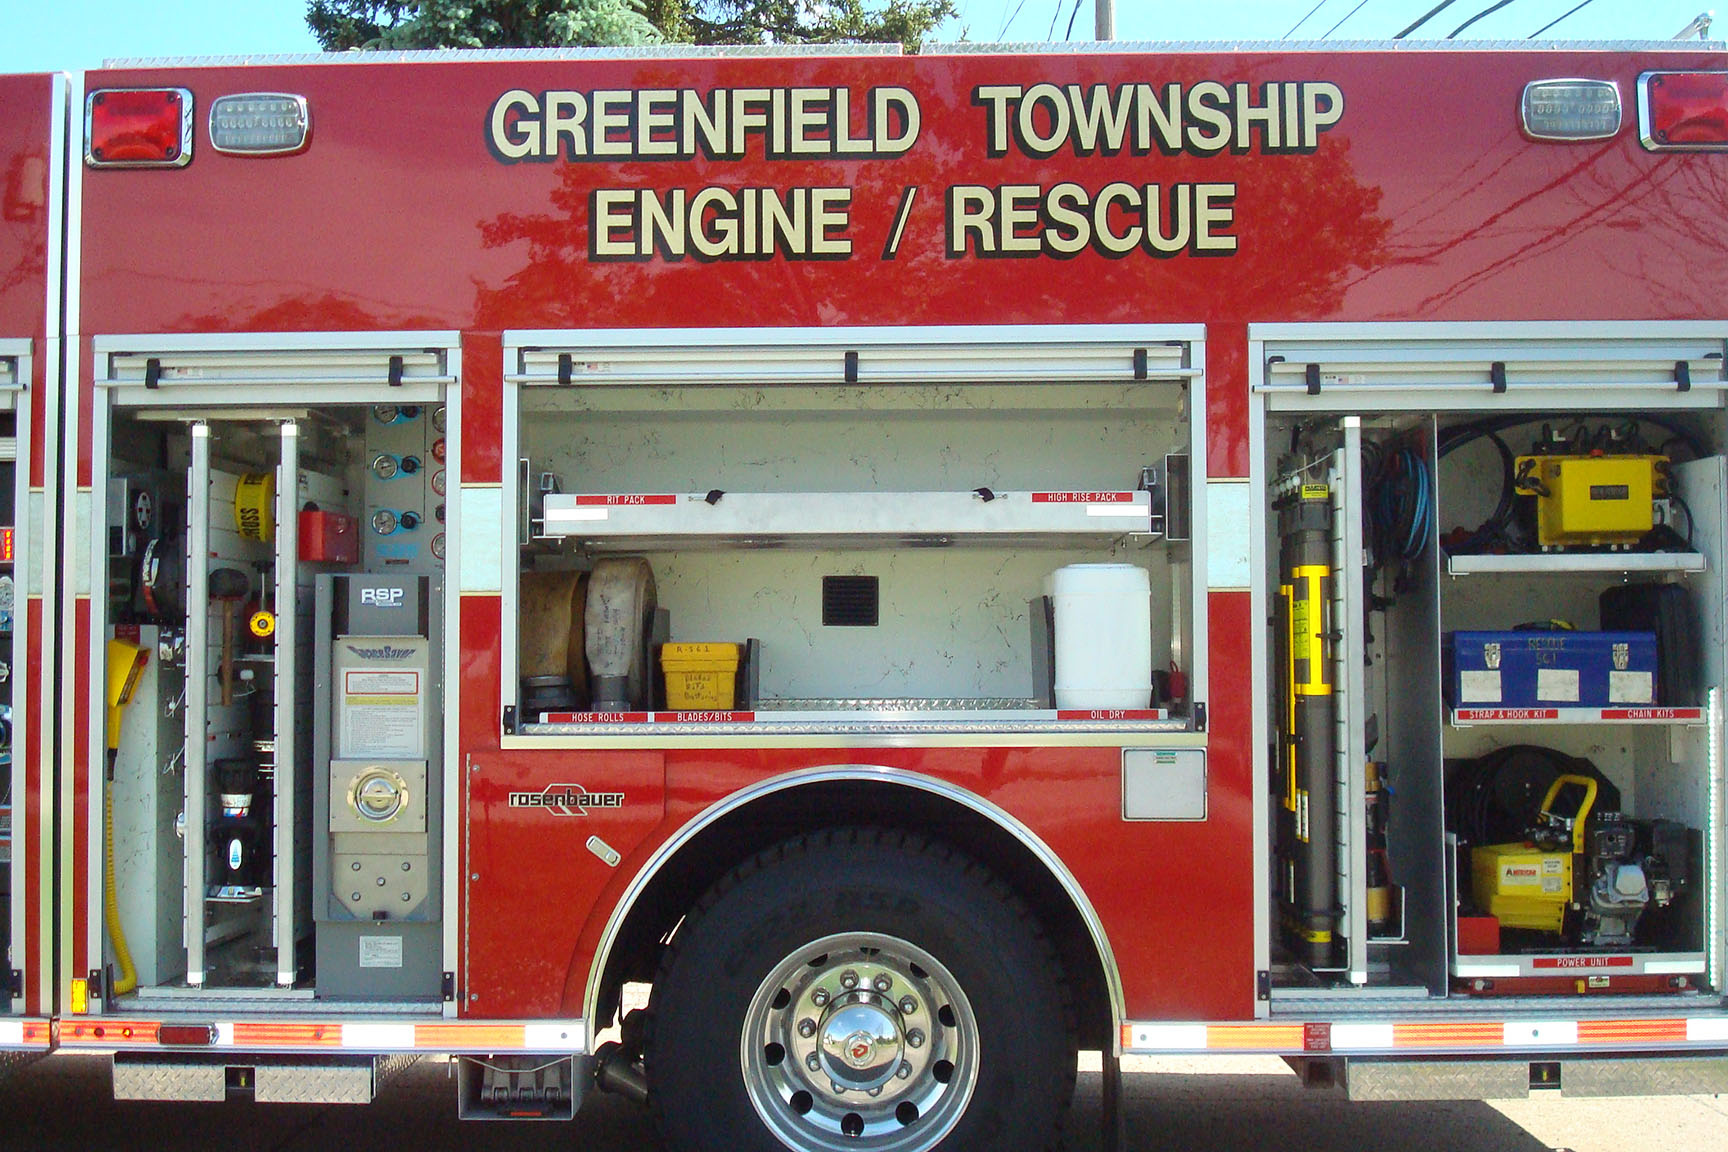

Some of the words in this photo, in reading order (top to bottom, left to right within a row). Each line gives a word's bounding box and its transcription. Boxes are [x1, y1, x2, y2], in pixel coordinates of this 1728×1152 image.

[487, 87, 921, 161] GREENFIELD
[973, 81, 1345, 156] TOWNSHIP
[591, 187, 852, 259] ENGINE
[884, 186, 918, 258] /
[948, 182, 1237, 257] RESCUE
[606, 494, 620, 505] RIT
[624, 494, 645, 505] PACK
[1048, 492, 1069, 502] HIGH
[1072, 492, 1092, 502] RISE
[1095, 492, 1117, 502] PACK
[240, 507, 261, 541] ROSS
[361, 588, 404, 604] RSP
[571, 713, 595, 722] HOSE
[599, 713, 624, 722] ROLLS
[677, 712, 733, 722] BLADES/BITS
[1090, 710, 1105, 719] OIL
[1109, 710, 1126, 719] DRY
[1469, 709, 1495, 719] STRAP
[1498, 709, 1504, 719] &
[1506, 709, 1529, 719] HOOK
[1533, 709, 1547, 719] KIT
[1627, 709, 1652, 719] CHAIN
[1656, 709, 1675, 719] KITS
[509, 788, 624, 807] rosenbauer
[1557, 958, 1586, 968] POWER
[1590, 957, 1609, 967] UNIT
